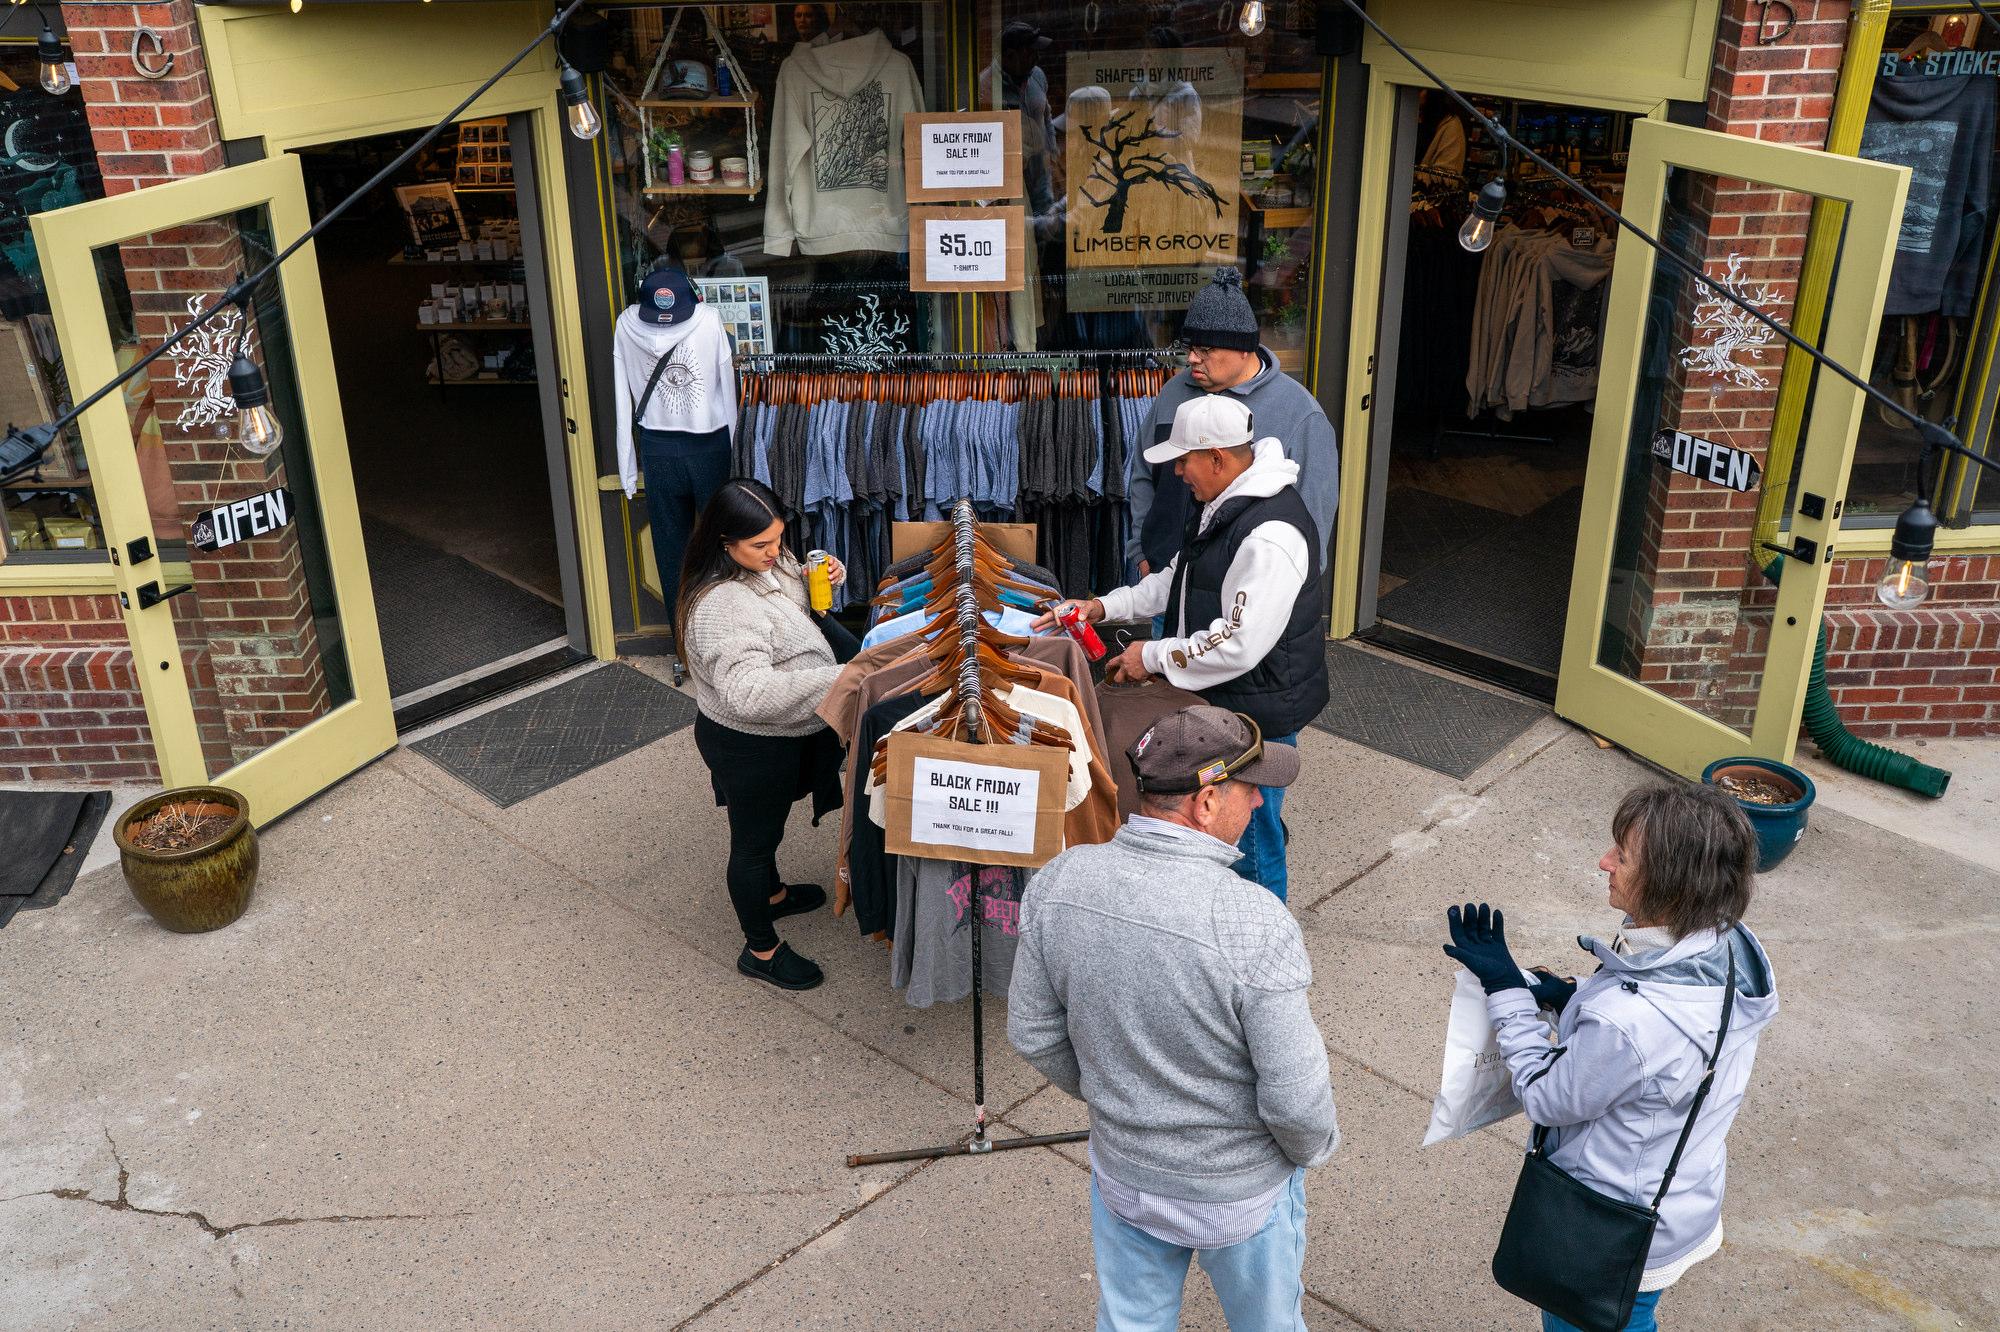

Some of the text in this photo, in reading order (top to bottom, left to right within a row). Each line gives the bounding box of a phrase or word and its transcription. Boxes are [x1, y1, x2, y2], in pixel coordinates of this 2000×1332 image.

[1881, 50, 2000, 76] S STICKE
[1095, 66, 1214, 83] SHAPED BY NATURE
[933, 132, 992, 143] BLACK FRIDAY
[946, 148, 979, 158] SALE !!!
[940, 233, 992, 256] $5.00
[1073, 233, 1231, 252] LIMBER GROVE
[1104, 272, 1198, 286] LOCAL PRODUCTS
[1107, 290, 1195, 304] PURPOSE DRIVEN
[1672, 431, 1751, 492] OPEN
[212, 489, 287, 548] OPEN
[931, 772, 1021, 796] BLACK FRIDAY
[949, 796, 999, 813] SALE !!!
